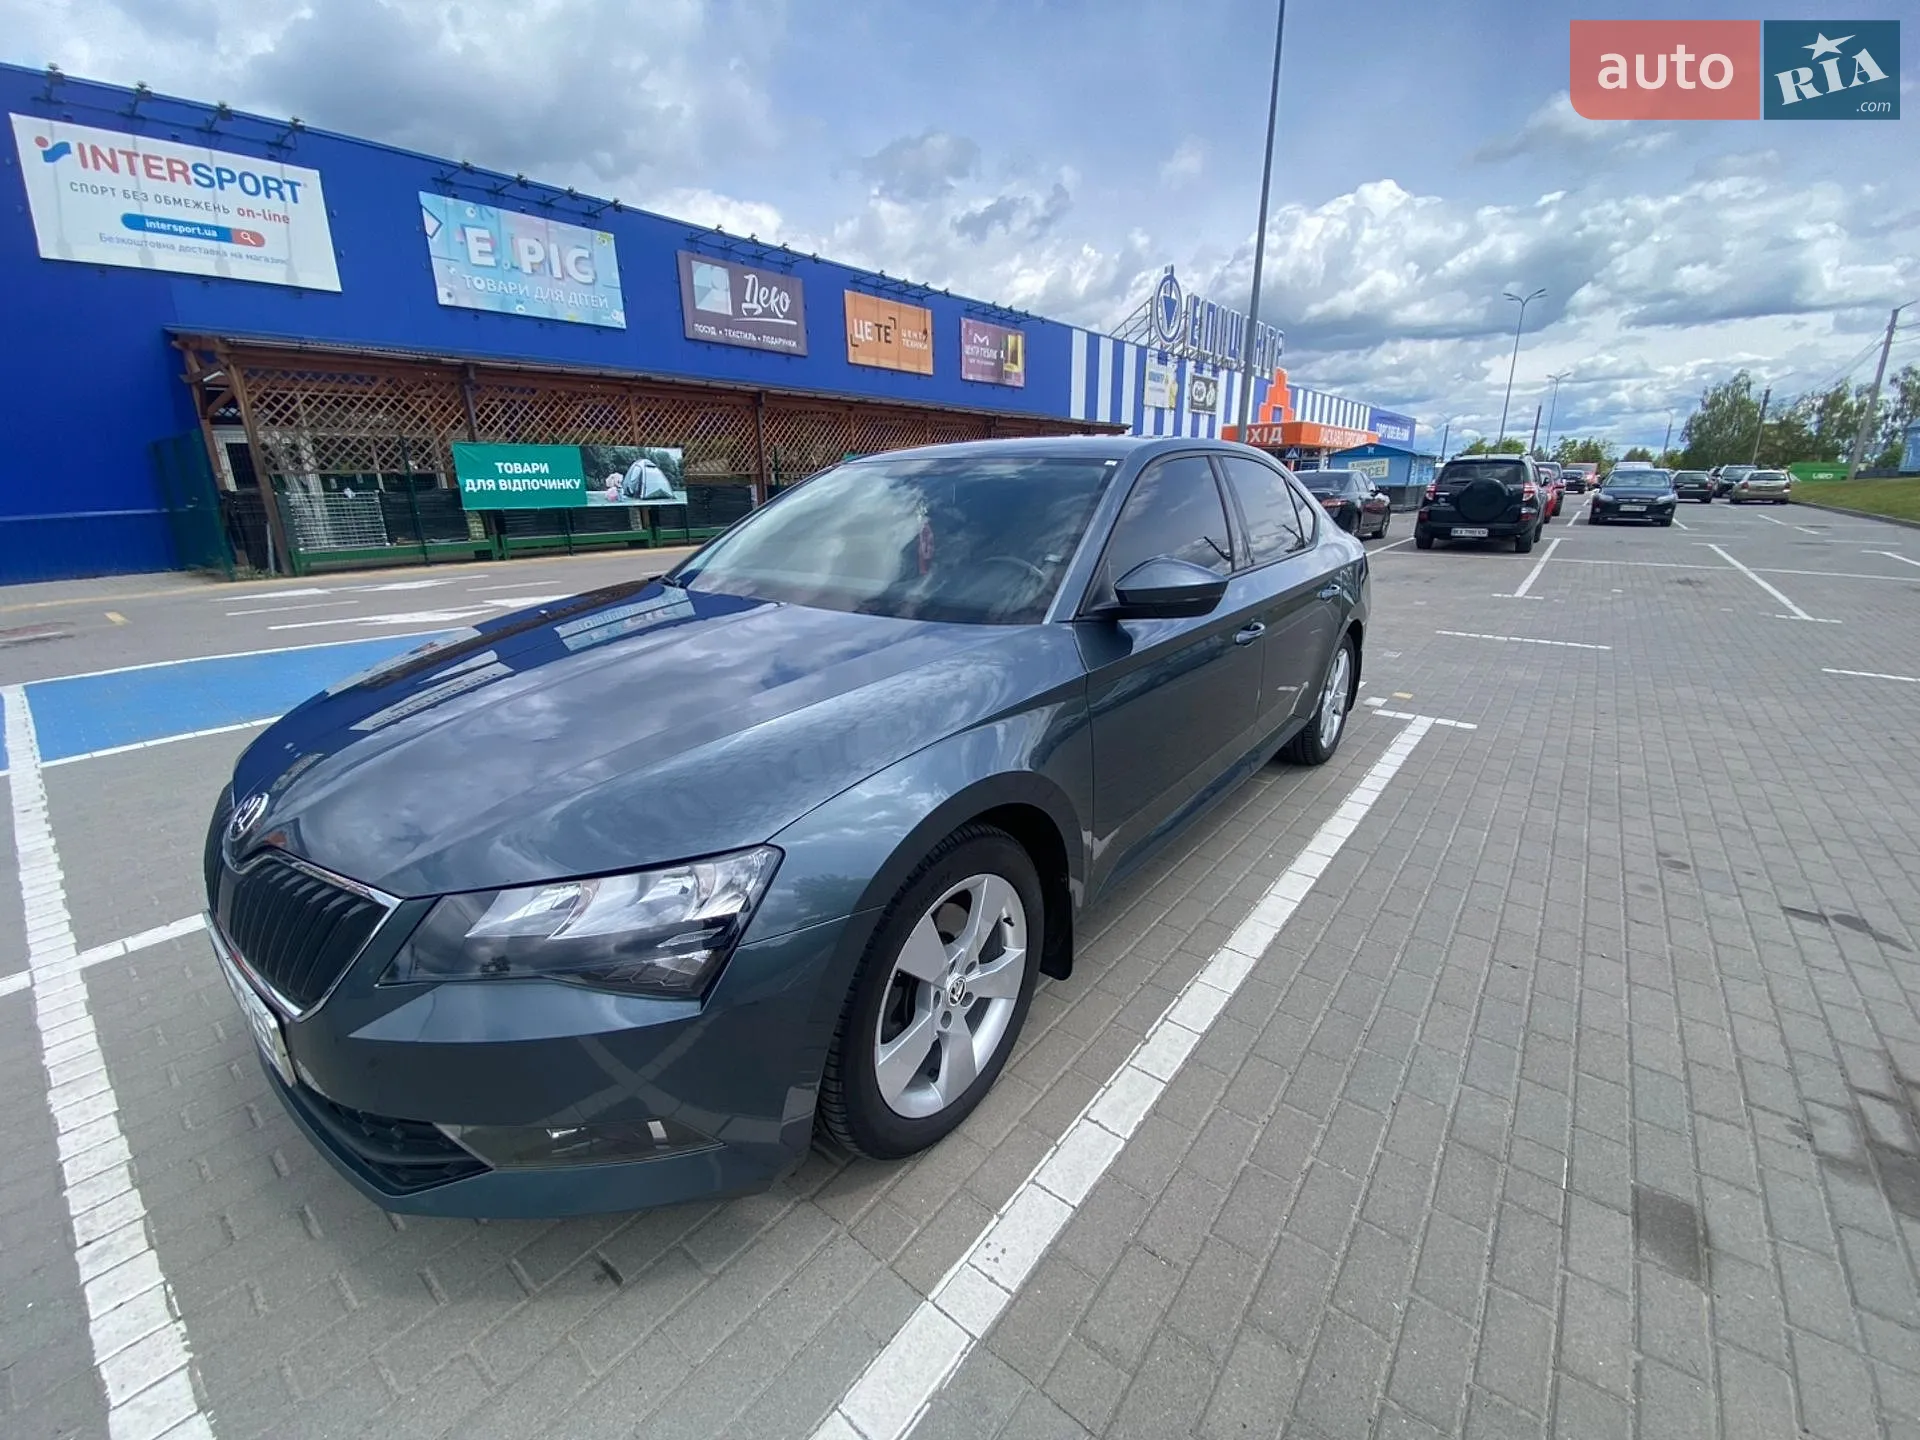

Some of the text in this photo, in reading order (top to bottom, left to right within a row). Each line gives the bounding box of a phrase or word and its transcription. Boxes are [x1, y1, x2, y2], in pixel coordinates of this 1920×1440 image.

[76, 141, 302, 204] INTERSPORT
[69, 180, 290, 225] СПОРТ БЕЗ ОБМЕЖЕНЬ on-line
[145, 218, 218, 238] intersport.ua
[99, 232, 176, 252] Безкоштовна
[462, 274, 609, 309] ТОВАРИ ДЛЯ ДІТЕЙ
[741, 273, 792, 318] Деко
[494, 461, 550, 474] ТОВАРИ
[465, 478, 582, 492] ДЛЯ ВІДПОЧИНКУ
